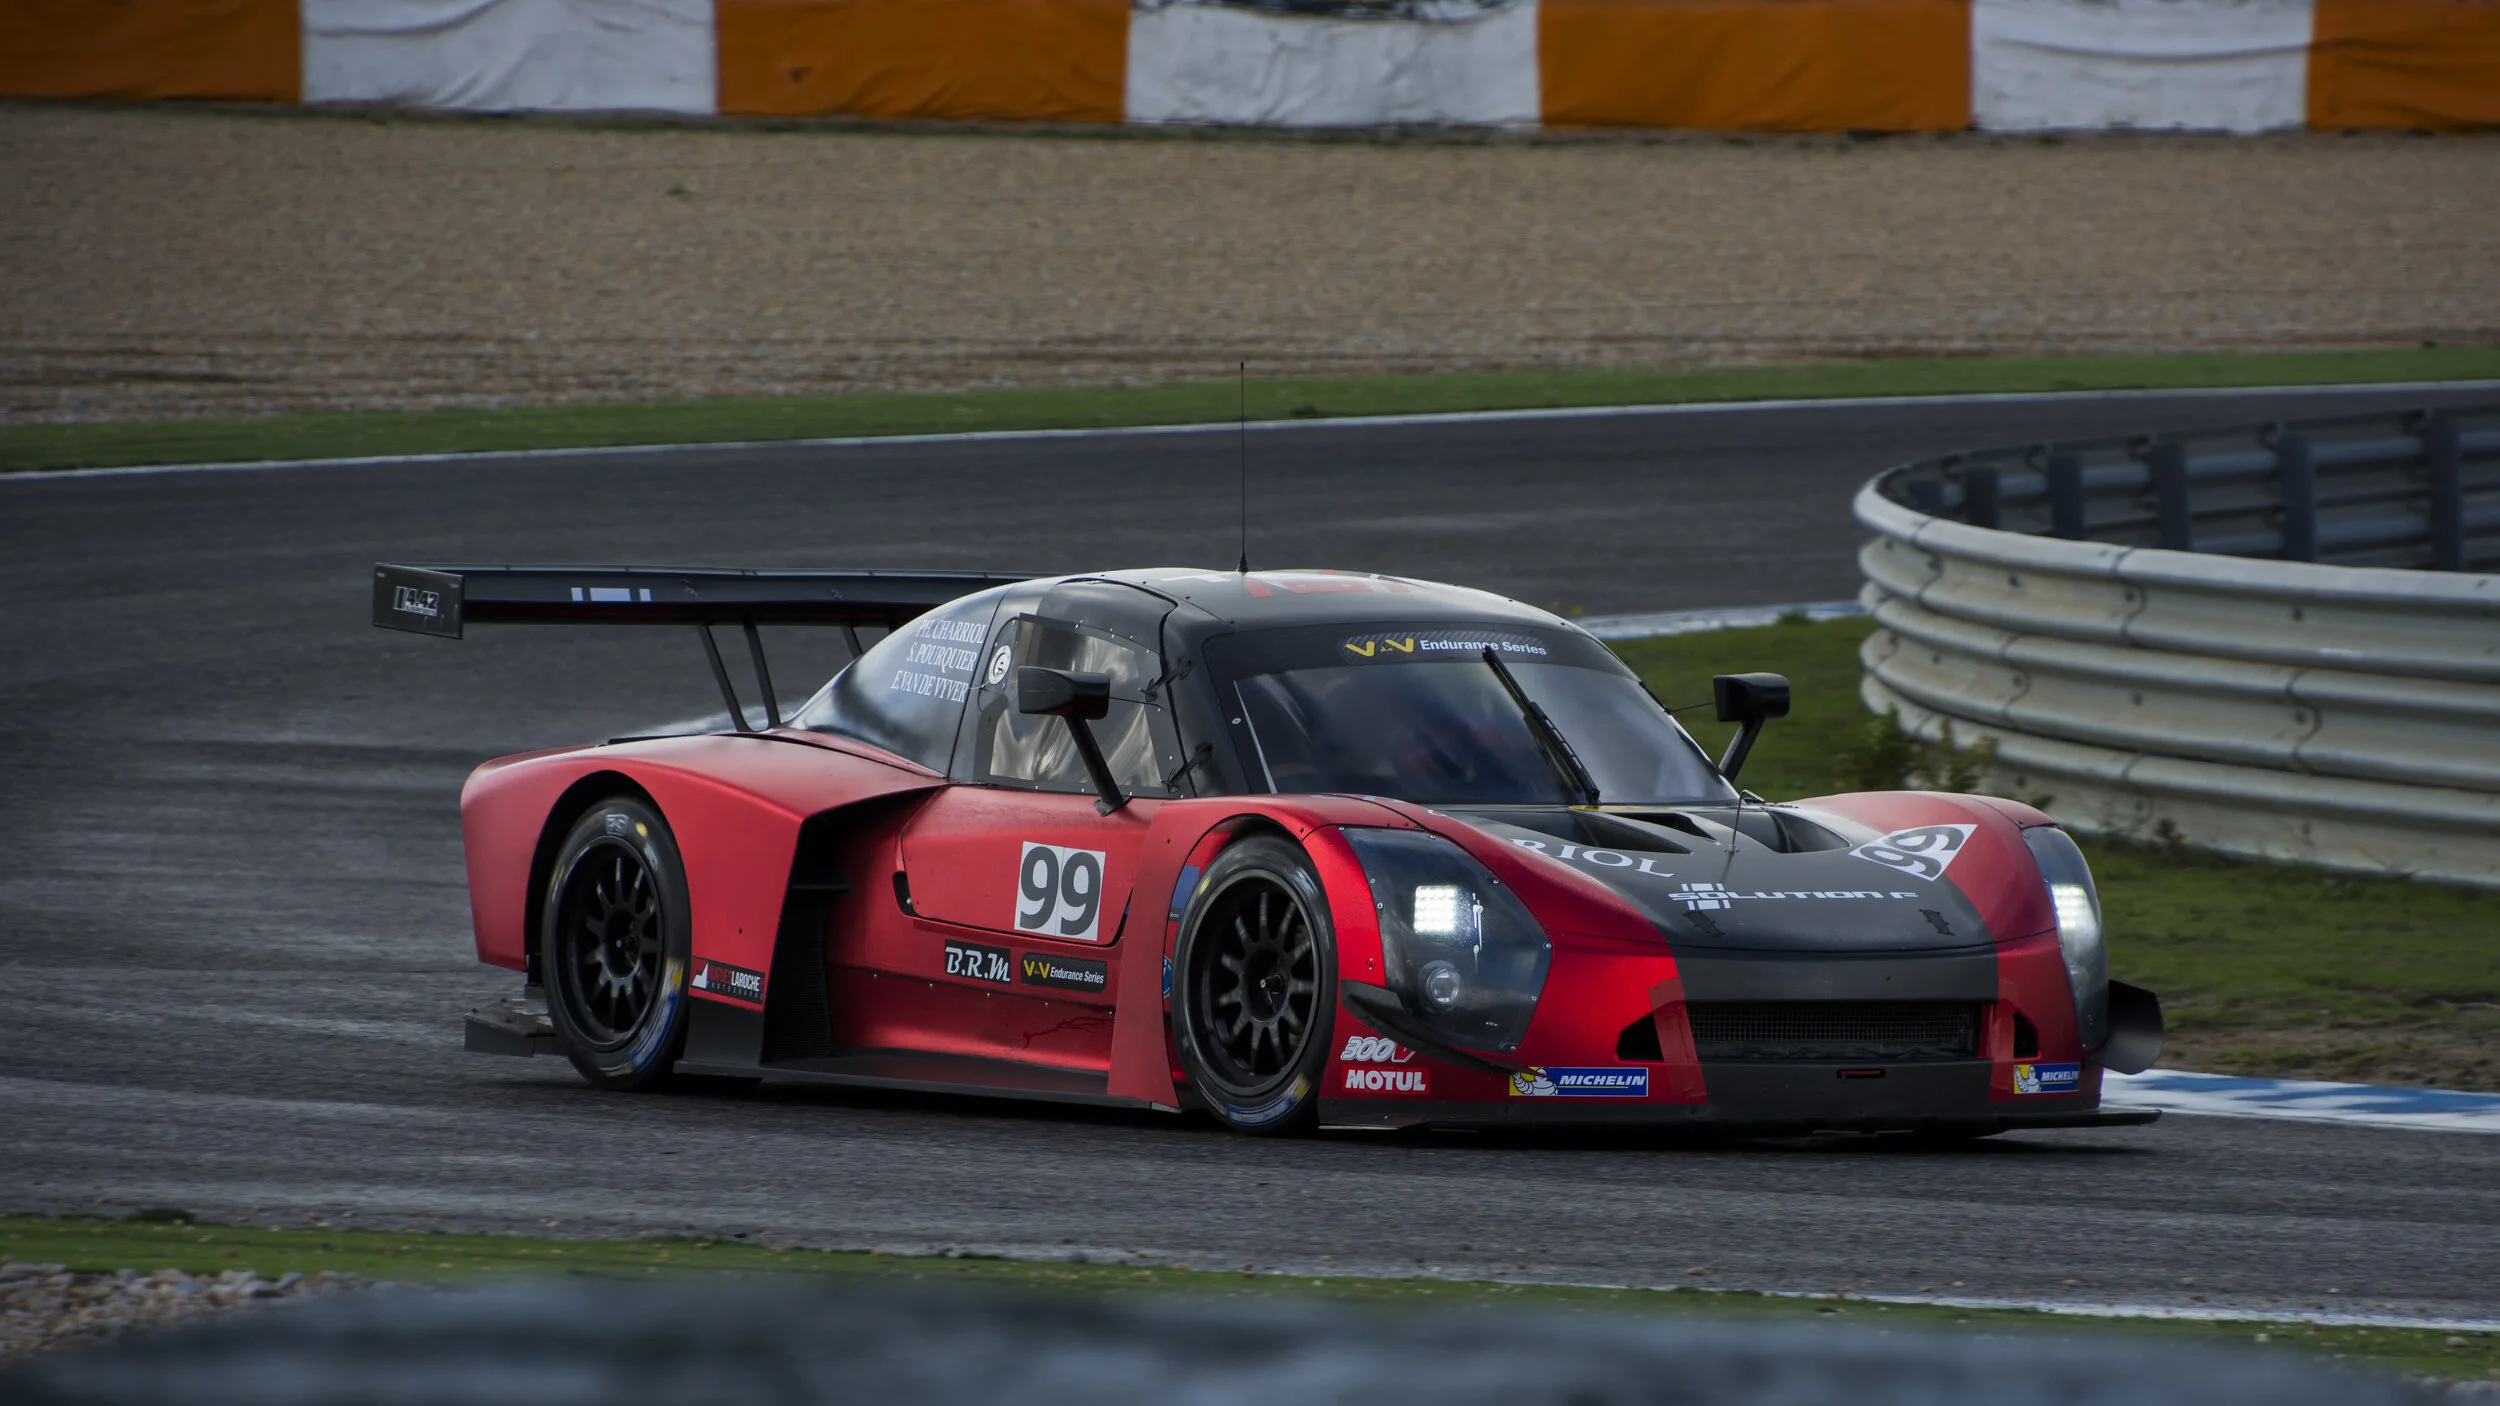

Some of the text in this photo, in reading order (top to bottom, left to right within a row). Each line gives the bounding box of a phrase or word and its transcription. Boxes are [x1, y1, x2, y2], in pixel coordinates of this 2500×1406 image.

[932, 619, 987, 644] CHARRIOL
[914, 643, 978, 673] POURQUIER
[1420, 639, 1498, 653] Endurance
[1502, 641, 1547, 656] Series
[934, 677, 969, 703] VYVER
[1859, 826, 1965, 878] 99
[1019, 846, 1101, 936] 99
[1668, 890, 1885, 901] SOLUTION
[731, 970, 760, 992] LAROCHE
[1050, 966, 1083, 982] Endurance
[1083, 970, 1104, 984] Series
[1345, 1069, 1427, 1092] MOTUL
[1559, 1075, 1646, 1086] MICHELIN
[2041, 1070, 2080, 1082] MICHELIN
